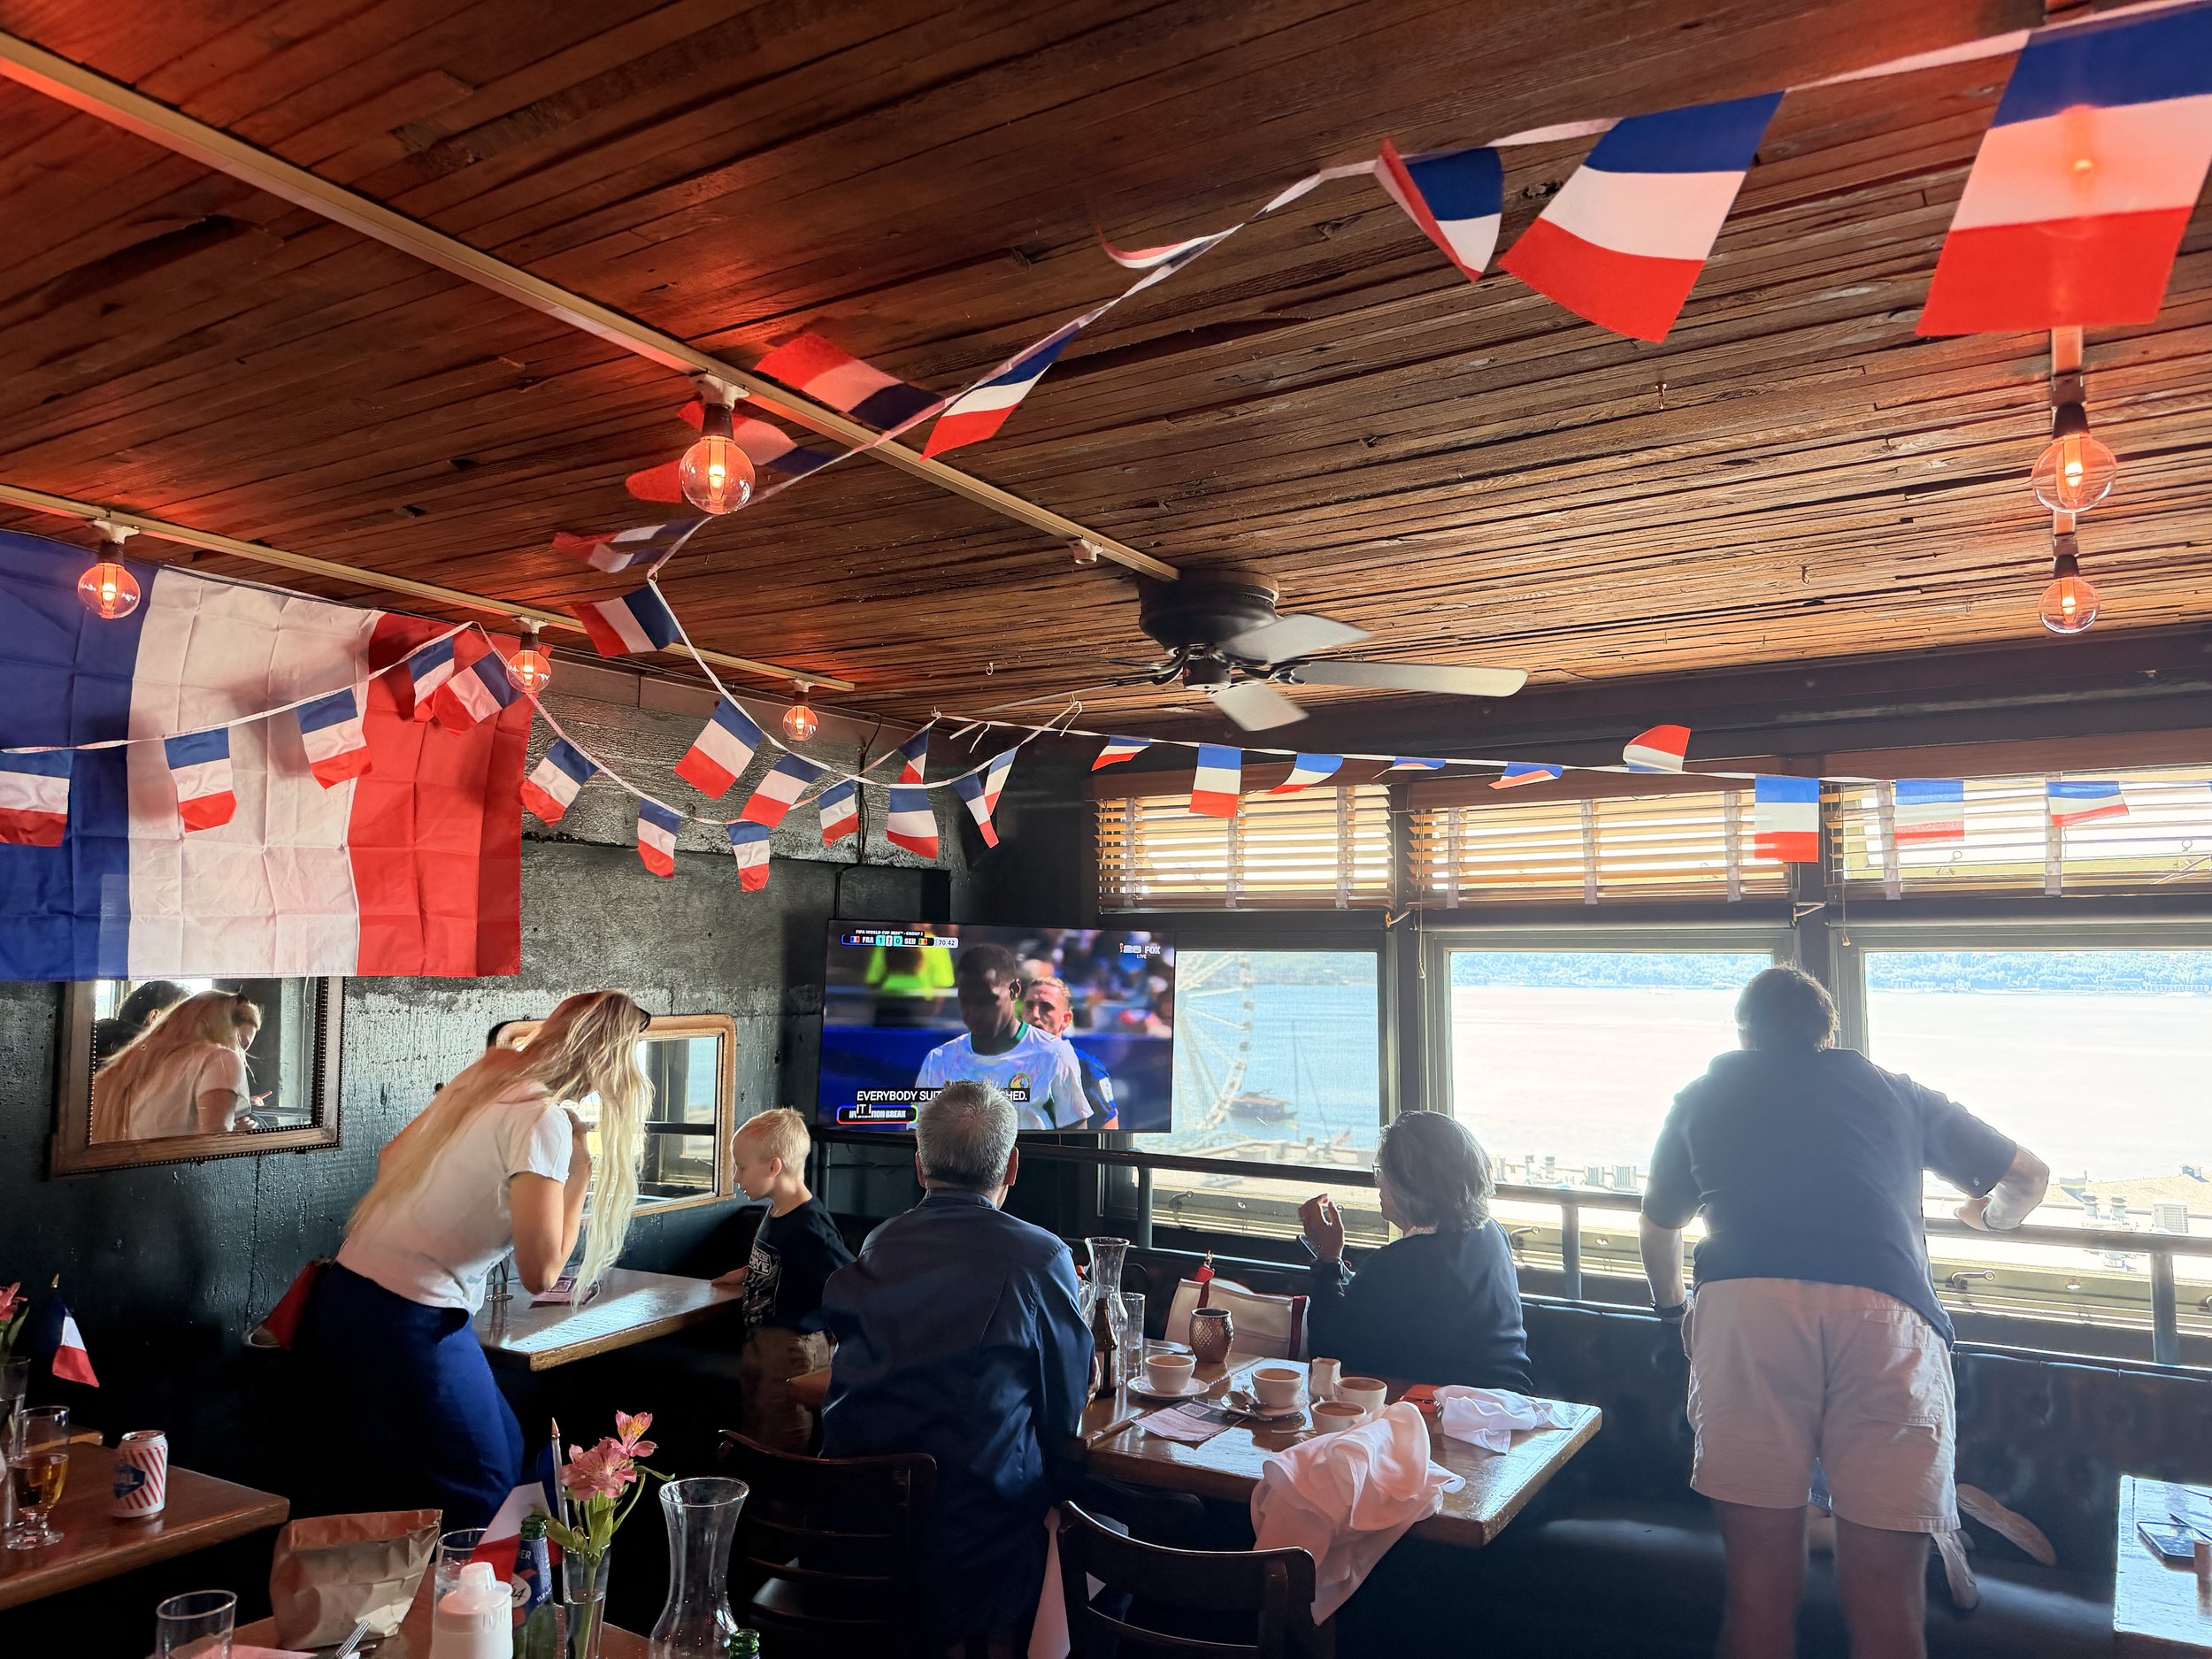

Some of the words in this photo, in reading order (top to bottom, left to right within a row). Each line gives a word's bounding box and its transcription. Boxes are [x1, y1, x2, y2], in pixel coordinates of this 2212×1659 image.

[856, 1090, 918, 1102] EVERYBODY
[856, 1103, 867, 1114] IT
[886, 1110, 907, 1118] BREAK
